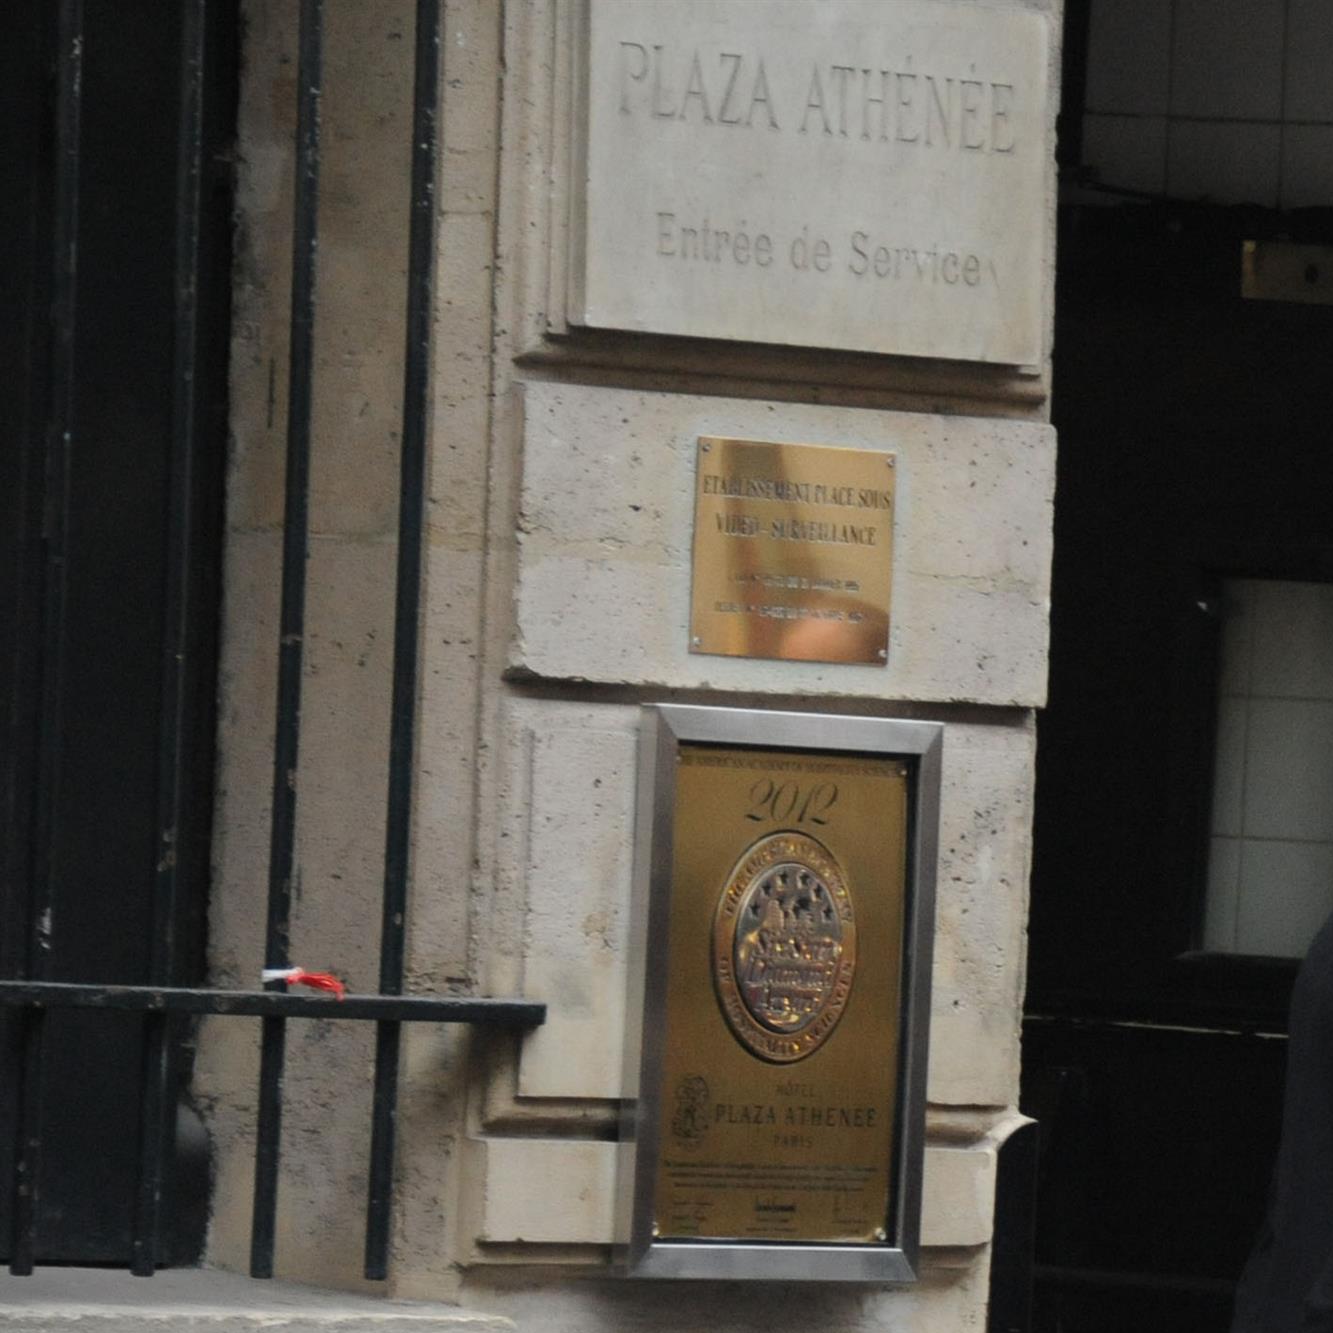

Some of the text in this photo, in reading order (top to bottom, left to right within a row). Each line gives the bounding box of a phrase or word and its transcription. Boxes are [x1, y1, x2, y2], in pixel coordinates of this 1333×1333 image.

[618, 40, 1017, 155] PLAZA ATHÉNÉE
[655, 210, 981, 288] Entrée de Service
[857, 487, 891, 510] SOUS
[744, 778, 839, 825] 2012
[714, 1103, 777, 1125] PLAZA
[773, 1134, 814, 1149] PARIS
